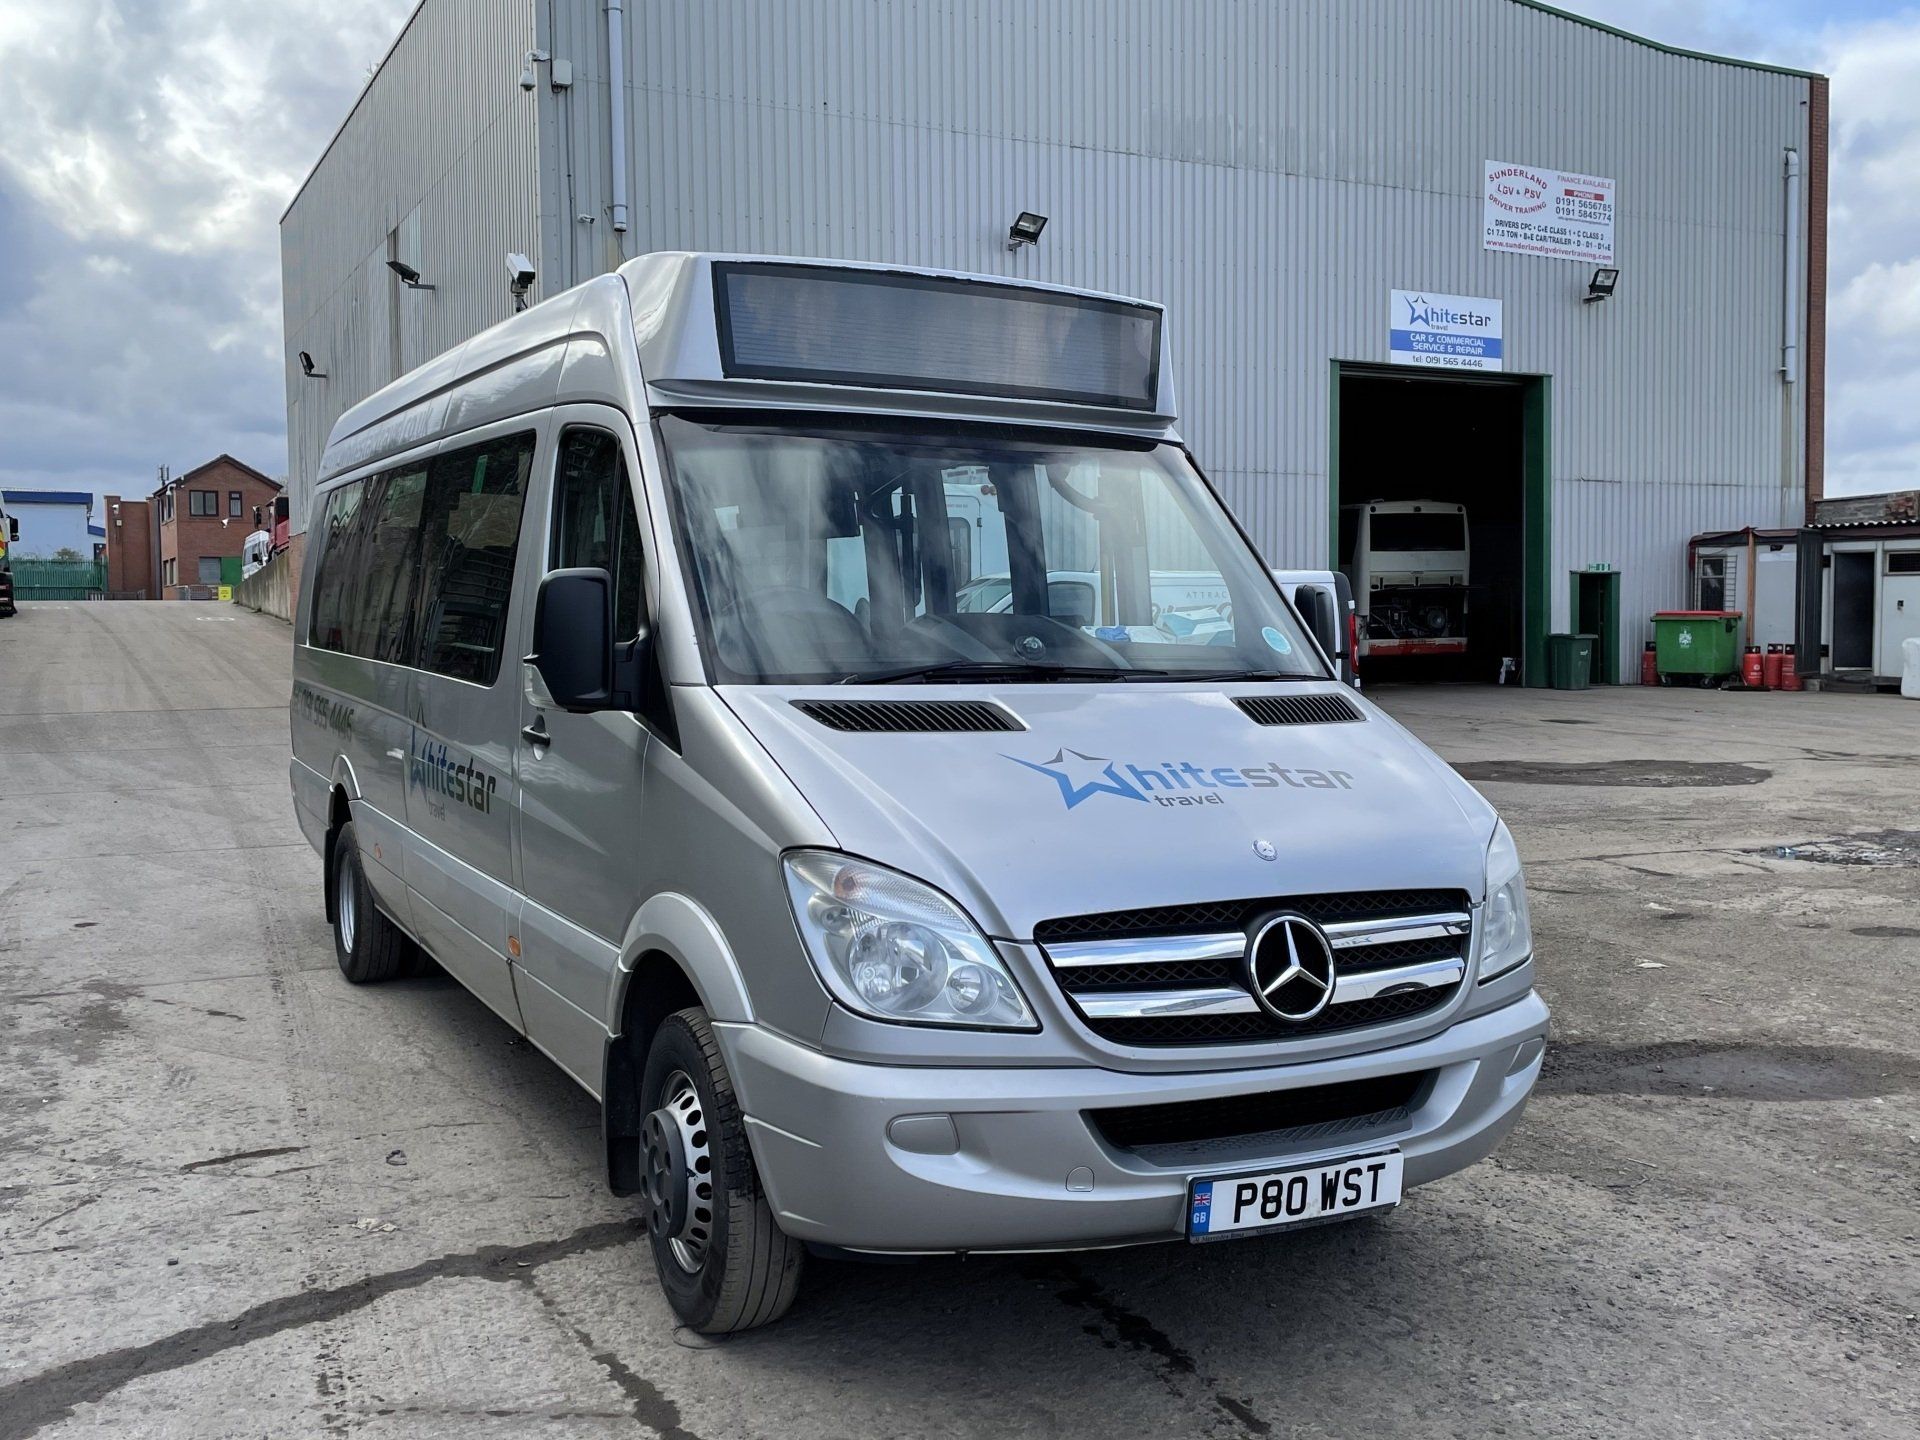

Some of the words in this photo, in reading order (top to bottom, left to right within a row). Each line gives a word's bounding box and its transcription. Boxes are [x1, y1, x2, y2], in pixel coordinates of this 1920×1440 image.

[1488, 168, 1548, 190] SUNDERLAND
[1557, 175, 1582, 185] FINANCE
[1582, 179, 1612, 189] AVAILABLE
[1497, 184, 1514, 196] LGV
[1524, 187, 1542, 200] PSV
[1573, 190, 1595, 199] PHONE
[1488, 193, 1513, 213] DRIVER
[1514, 201, 1547, 214] TRAINING
[1555, 197, 1575, 206] 0191
[1555, 206, 1575, 216] 0191
[1495, 219, 1519, 230] DRIVERS
[1520, 222, 1532, 231] CPC
[1549, 226, 1567, 236] CLASS
[1582, 231, 1599, 240] CLASS
[1506, 230, 1518, 238] TON
[1431, 323, 1449, 331] travel
[1410, 333, 1426, 342] CAR
[1428, 335, 1434, 343] &
[1436, 336, 1486, 347] COMMERCIAL
[1412, 342, 1445, 352] SERVICE
[1447, 345, 1453, 353] &
[1456, 346, 1483, 355] REPAIR
[1425, 356, 1441, 364] 0191
[1443, 358, 1459, 366] 565
[1461, 359, 1483, 367] 4446
[1154, 791, 1226, 808] travel
[1233, 1175, 1309, 1224] P80
[1321, 1162, 1387, 1212] WST
[1193, 1212, 1207, 1224] GB
